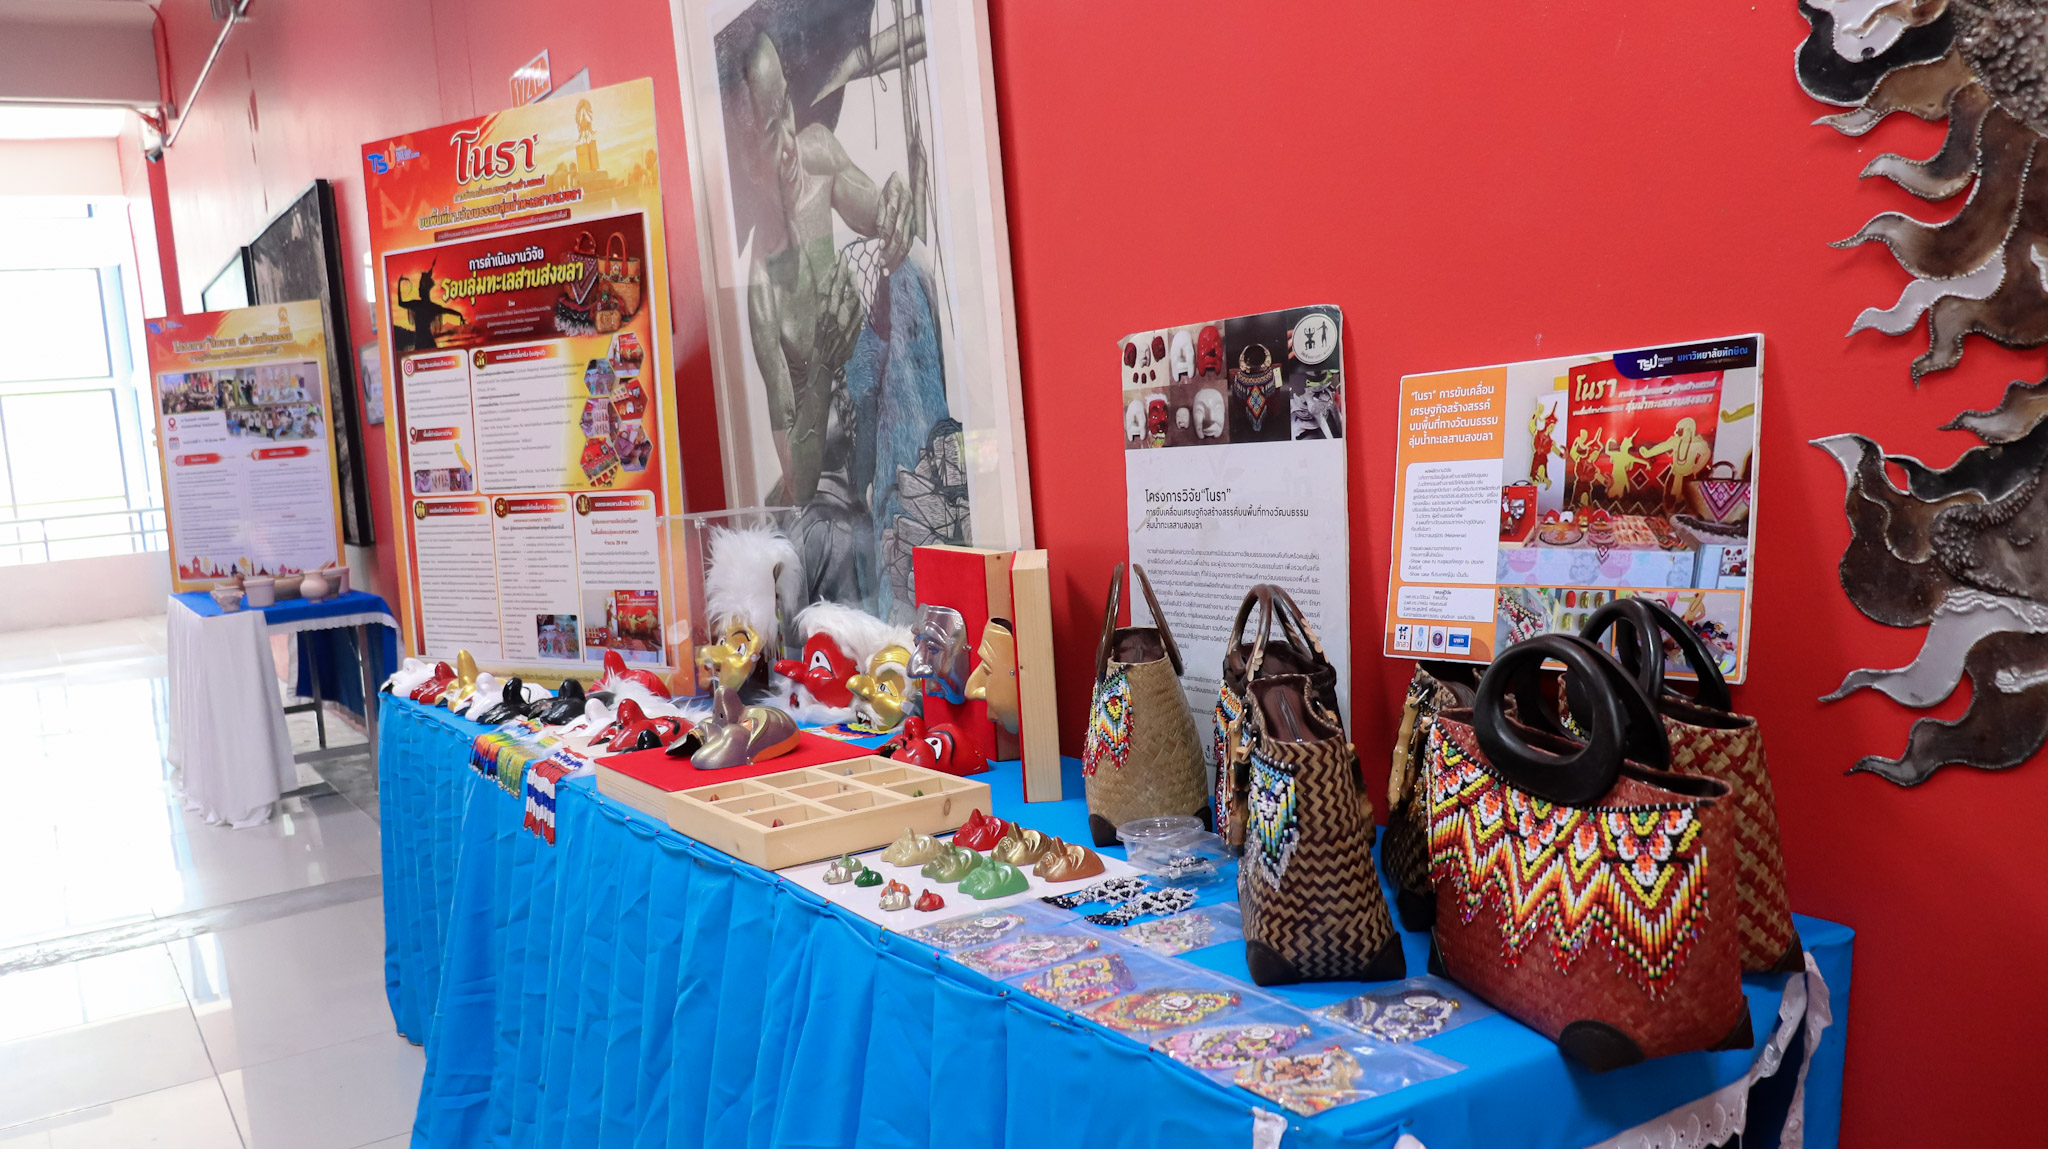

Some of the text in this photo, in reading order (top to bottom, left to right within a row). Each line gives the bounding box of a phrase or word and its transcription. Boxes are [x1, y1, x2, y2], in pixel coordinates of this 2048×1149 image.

[469, 245, 544, 270] การดำเนินงานวิจัย
[441, 261, 584, 305] รอบลุ่มทะเลสาบสงขลา
[1677, 346, 1748, 362] มหาวิทยาลัยทักษิณ
[1439, 380, 1495, 398] การขับเคลื่อน
[1574, 374, 1617, 402] โนรา
[1410, 398, 1491, 417] เศรษฐกิจสร้างสรรค์
[1409, 416, 1499, 431] บนพื้นที่ทางวัฒนธรรม
[1408, 430, 1494, 449] ลุ่มน้ำทะเลสาบสงขลา
[1146, 504, 1309, 519] การขับเคลื่อนเศรษฐกิจสร้างสรรค์บนพื้นที่ทางวัฒนธรรม
[1146, 517, 1203, 531] ลุ่มน้ำทะเลสาบสงขลา
